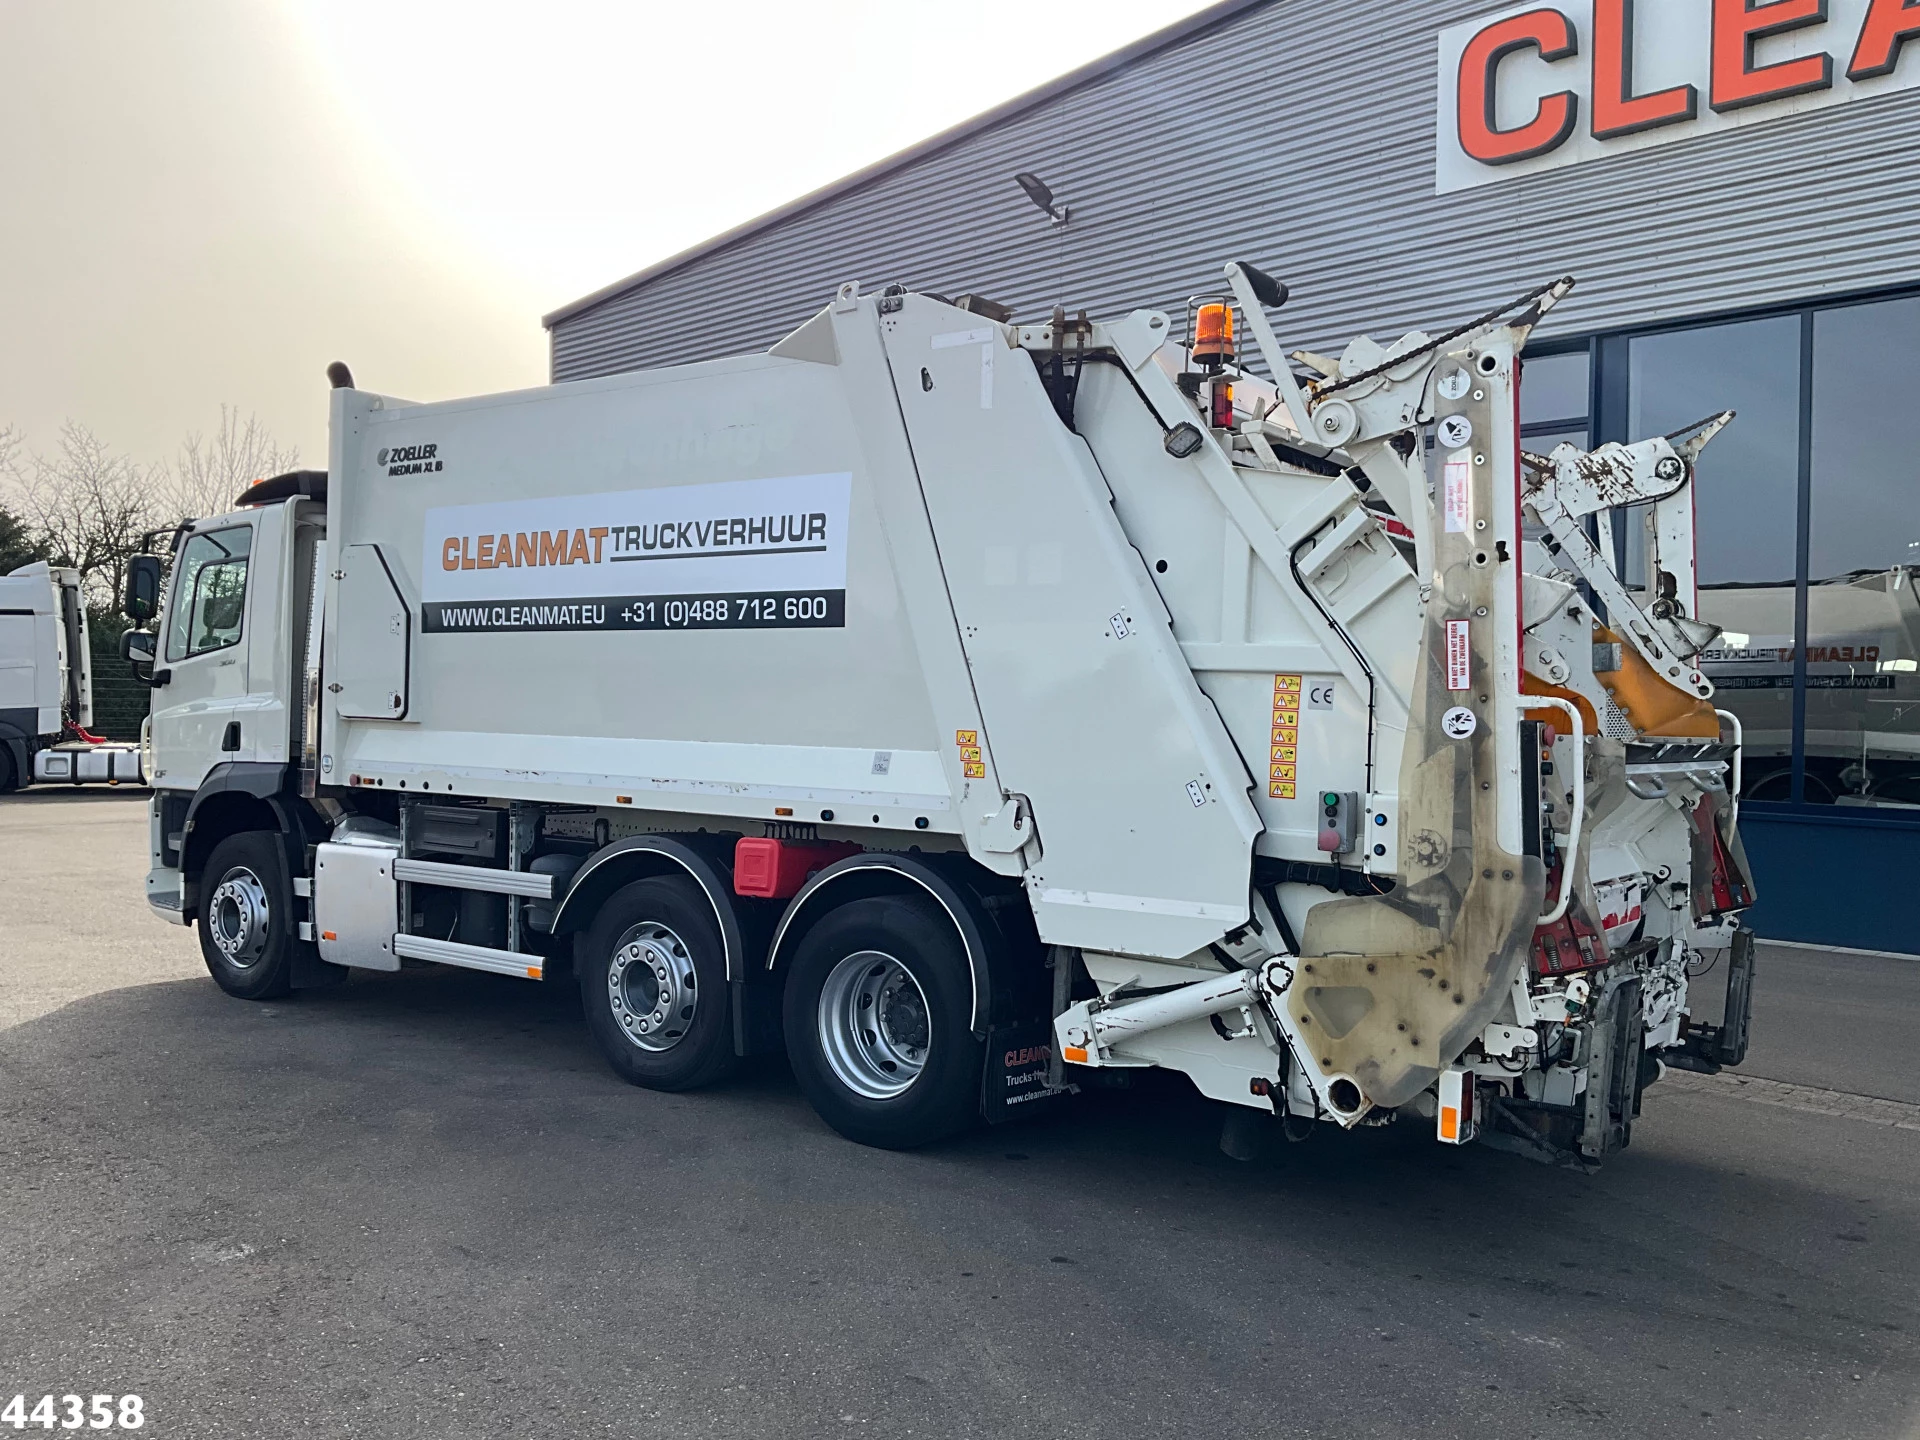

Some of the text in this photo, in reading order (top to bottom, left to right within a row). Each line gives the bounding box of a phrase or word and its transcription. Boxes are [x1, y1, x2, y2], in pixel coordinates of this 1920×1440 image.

[390, 443, 438, 463] ZOELLER
[388, 463, 423, 477] MEDIUM
[423, 461, 434, 473] XL
[442, 512, 827, 571] CLEANMAT TRUCKVERHUUR
[441, 597, 827, 627] WWW.CLEANMAT.EU +31 (0)488 712 600
[1310, 688, 1333, 704] CE
[1006, 1071, 1032, 1086] Trucks
